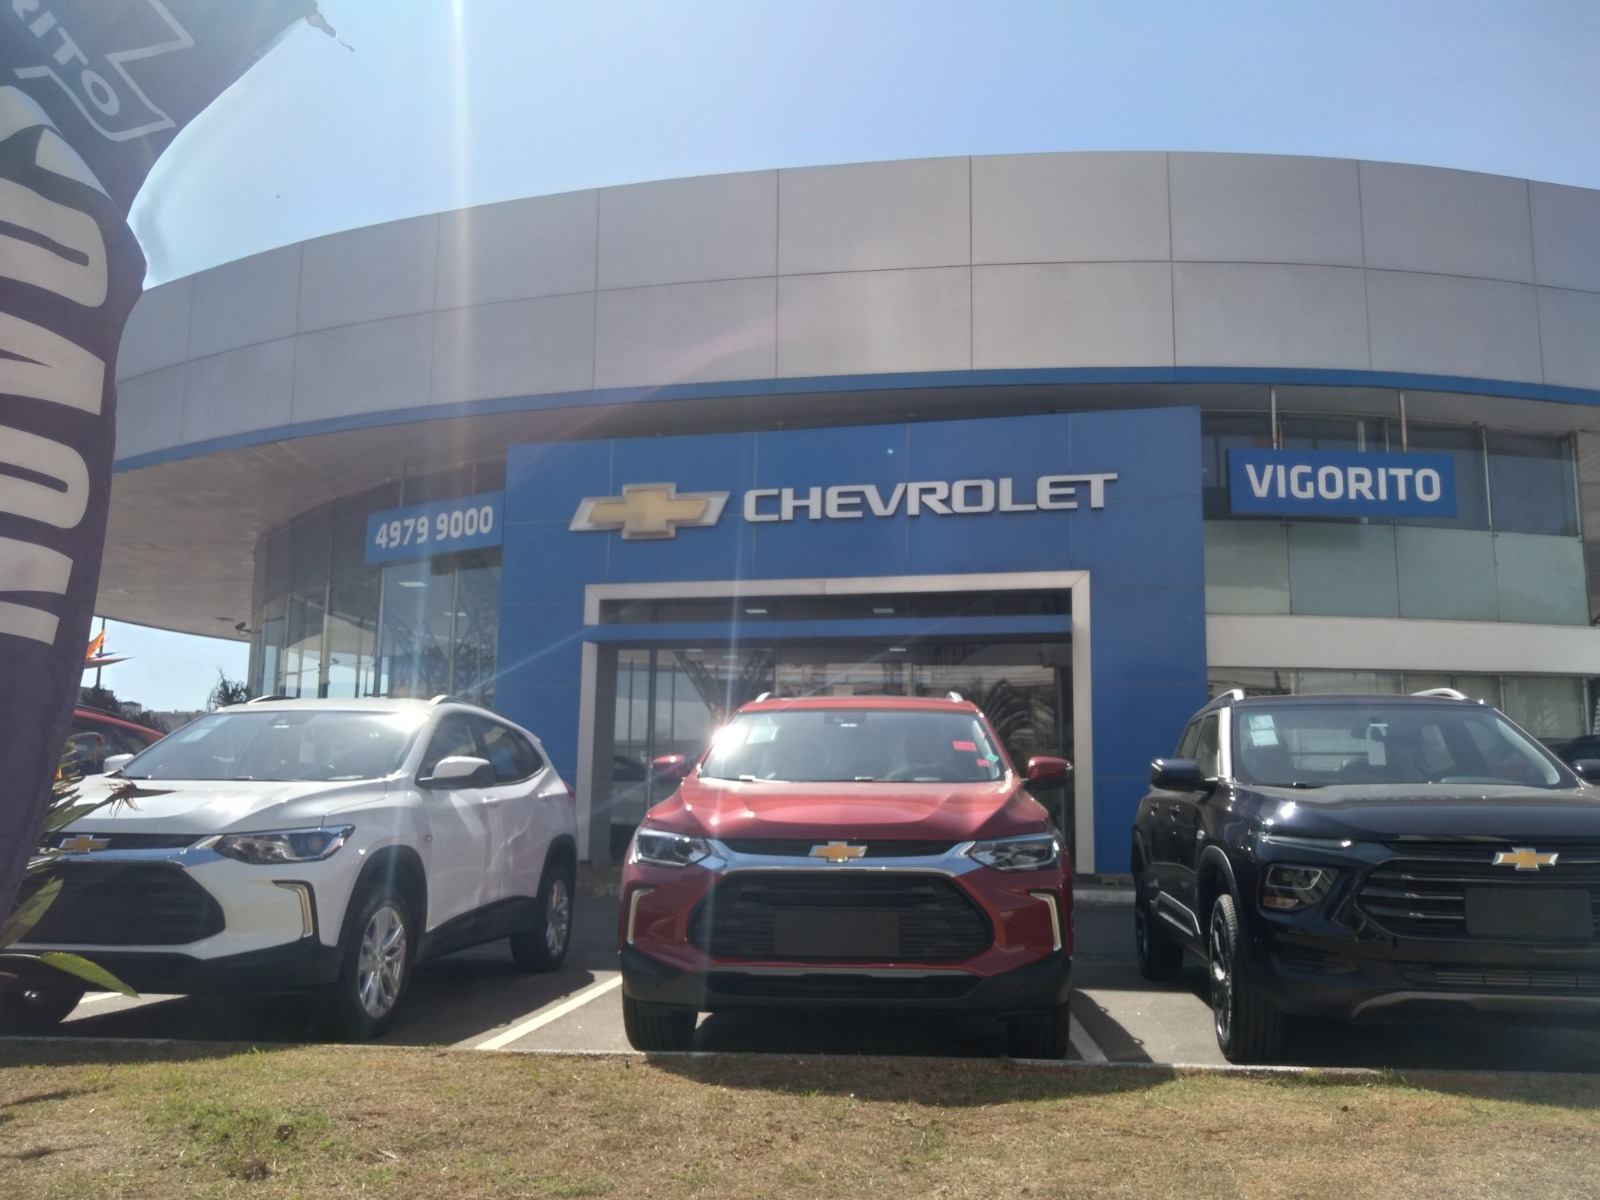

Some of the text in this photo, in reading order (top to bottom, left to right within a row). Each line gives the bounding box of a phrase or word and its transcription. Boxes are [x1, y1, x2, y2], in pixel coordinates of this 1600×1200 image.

[743, 472, 1119, 522] CHEVROLET
[1245, 463, 1442, 502] VIGORITO
[374, 505, 494, 549] 4979 9000
